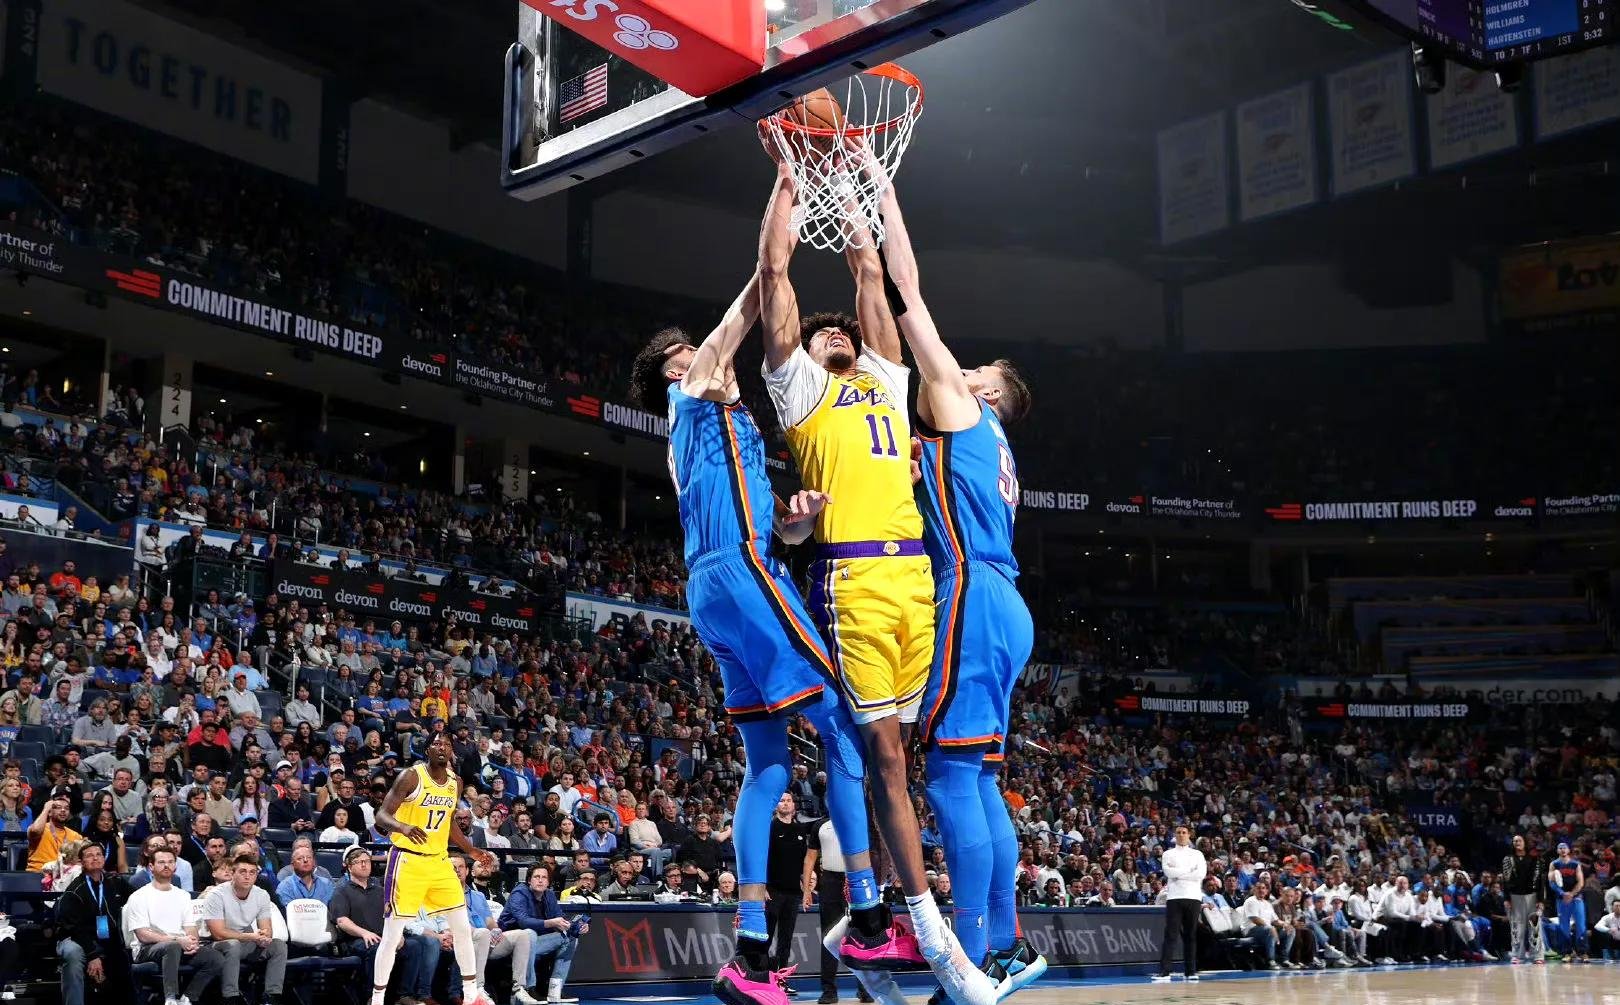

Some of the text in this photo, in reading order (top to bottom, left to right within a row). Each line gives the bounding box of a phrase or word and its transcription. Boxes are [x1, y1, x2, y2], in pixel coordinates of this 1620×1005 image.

[1486, 0, 1529, 15] HOLMGREN
[1486, 11, 1605, 30] WILLIAMS 2 0
[1488, 27, 1541, 46] HARTENSTEIN
[1558, 35, 1572, 46] 1ST
[63, 17, 293, 142] TOGETHER
[39, 243, 55, 257] of
[17, 251, 64, 273] Thunder
[167, 279, 383, 358] COMMITMENT RUNS DEEP
[402, 354, 442, 377] devon
[456, 359, 547, 393] Founding Partner of
[455, 373, 554, 407] the Oklahoma City Thunder
[865, 413, 898, 457] 11
[764, 457, 786, 470] evon
[998, 442, 1019, 506] 5
[1023, 489, 1056, 509] RUNS
[1058, 492, 1089, 511] DEEP
[1107, 501, 1140, 513] devon
[1152, 496, 1234, 509] Founding Partner of
[1305, 499, 1532, 520] COMMITMENT RUNS DEEP devon
[1545, 496, 1591, 507] Founding
[1214, 510, 1240, 518] Thunder
[278, 580, 323, 599] devon
[335, 589, 379, 608] devon
[390, 597, 431, 616] devon
[491, 612, 528, 630] devon
[1141, 697, 1249, 714] COMMITMENT RUNS DEEP
[1347, 704, 1469, 717] COMMITMENT RUNS DEEP
[420, 793, 453, 808] LAKERS
[425, 809, 446, 830] 17
[1409, 813, 1457, 826] LTRA
[1022, 925, 1159, 955] IDFIRST BANK
